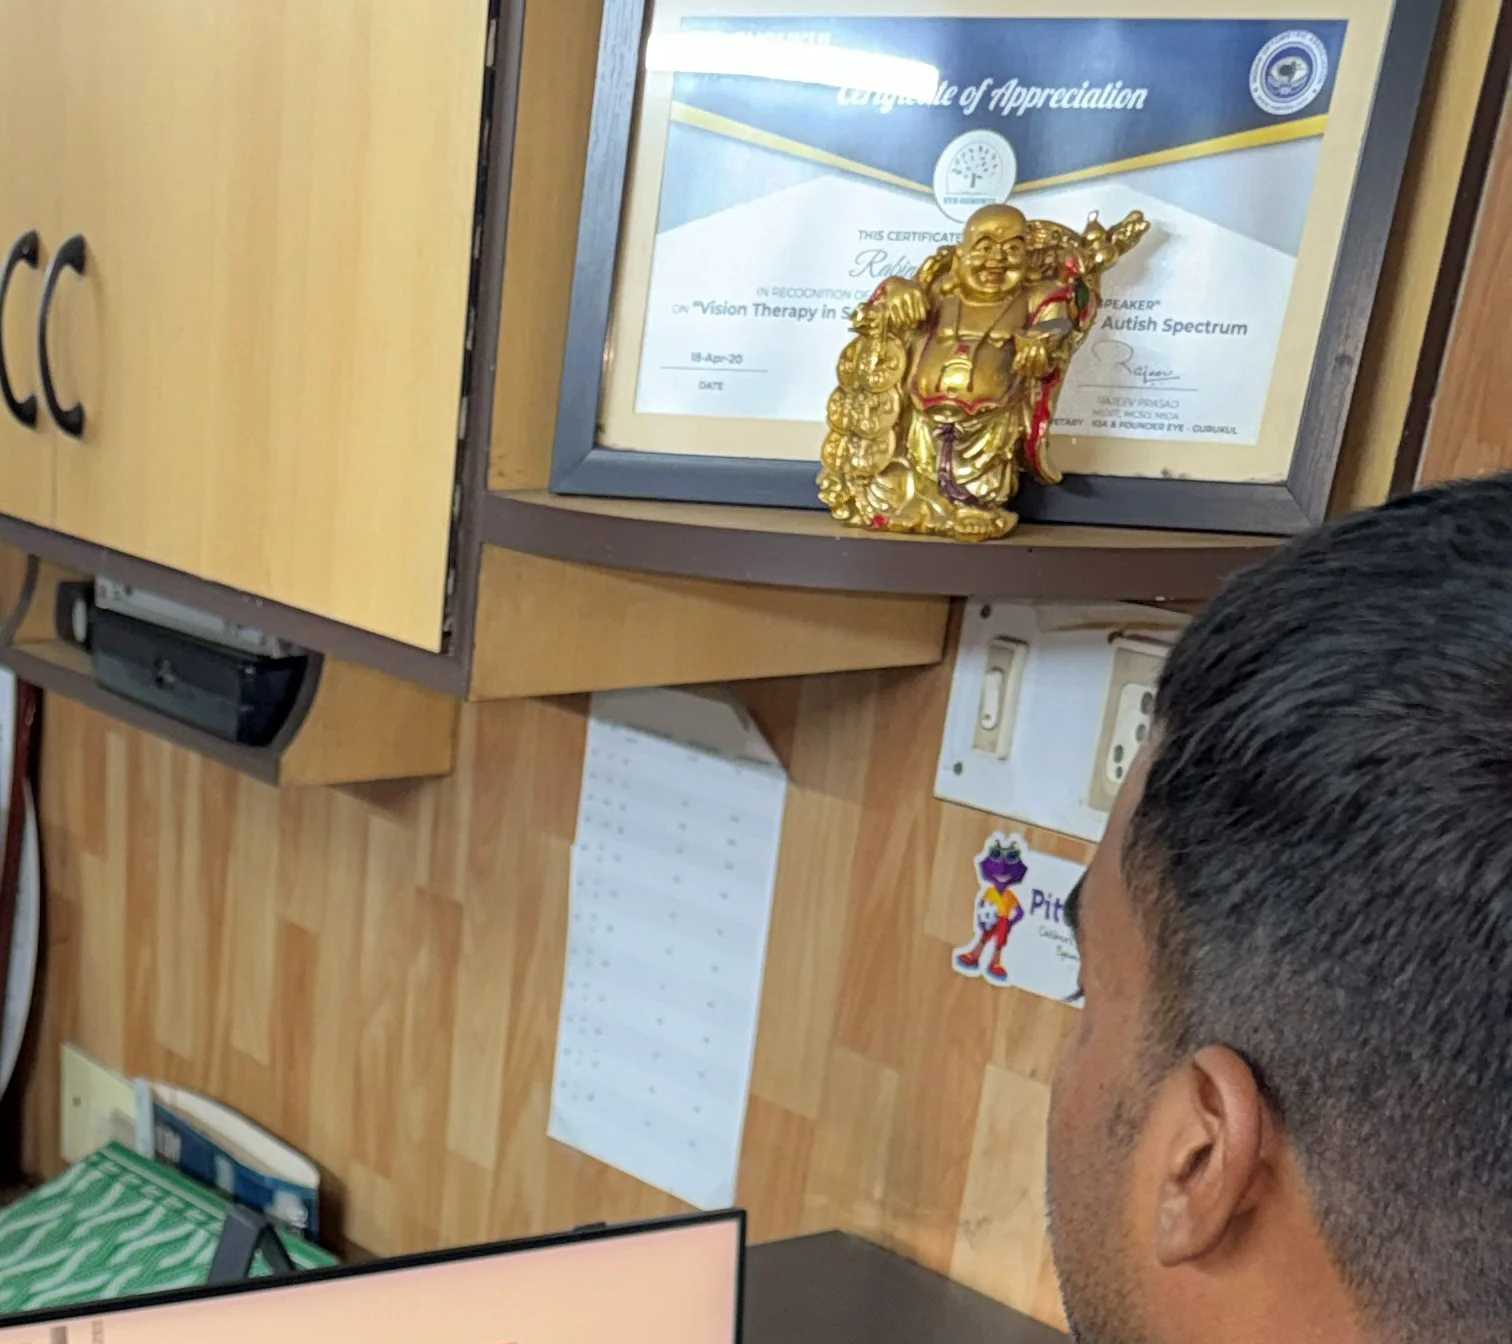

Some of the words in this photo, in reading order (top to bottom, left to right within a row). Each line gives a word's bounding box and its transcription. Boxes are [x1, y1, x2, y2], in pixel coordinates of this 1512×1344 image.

[959, 78, 993, 115] of
[988, 78, 1148, 116] Appreciation
[858, 230, 885, 241] THIS
[887, 231, 961, 243] CERTIFICATE
[752, 303, 817, 322] Therapy
[822, 304, 836, 319] in
[1100, 315, 1157, 332] Autish
[1162, 317, 1248, 336] Spectrum
[698, 380, 724, 391] DATE
